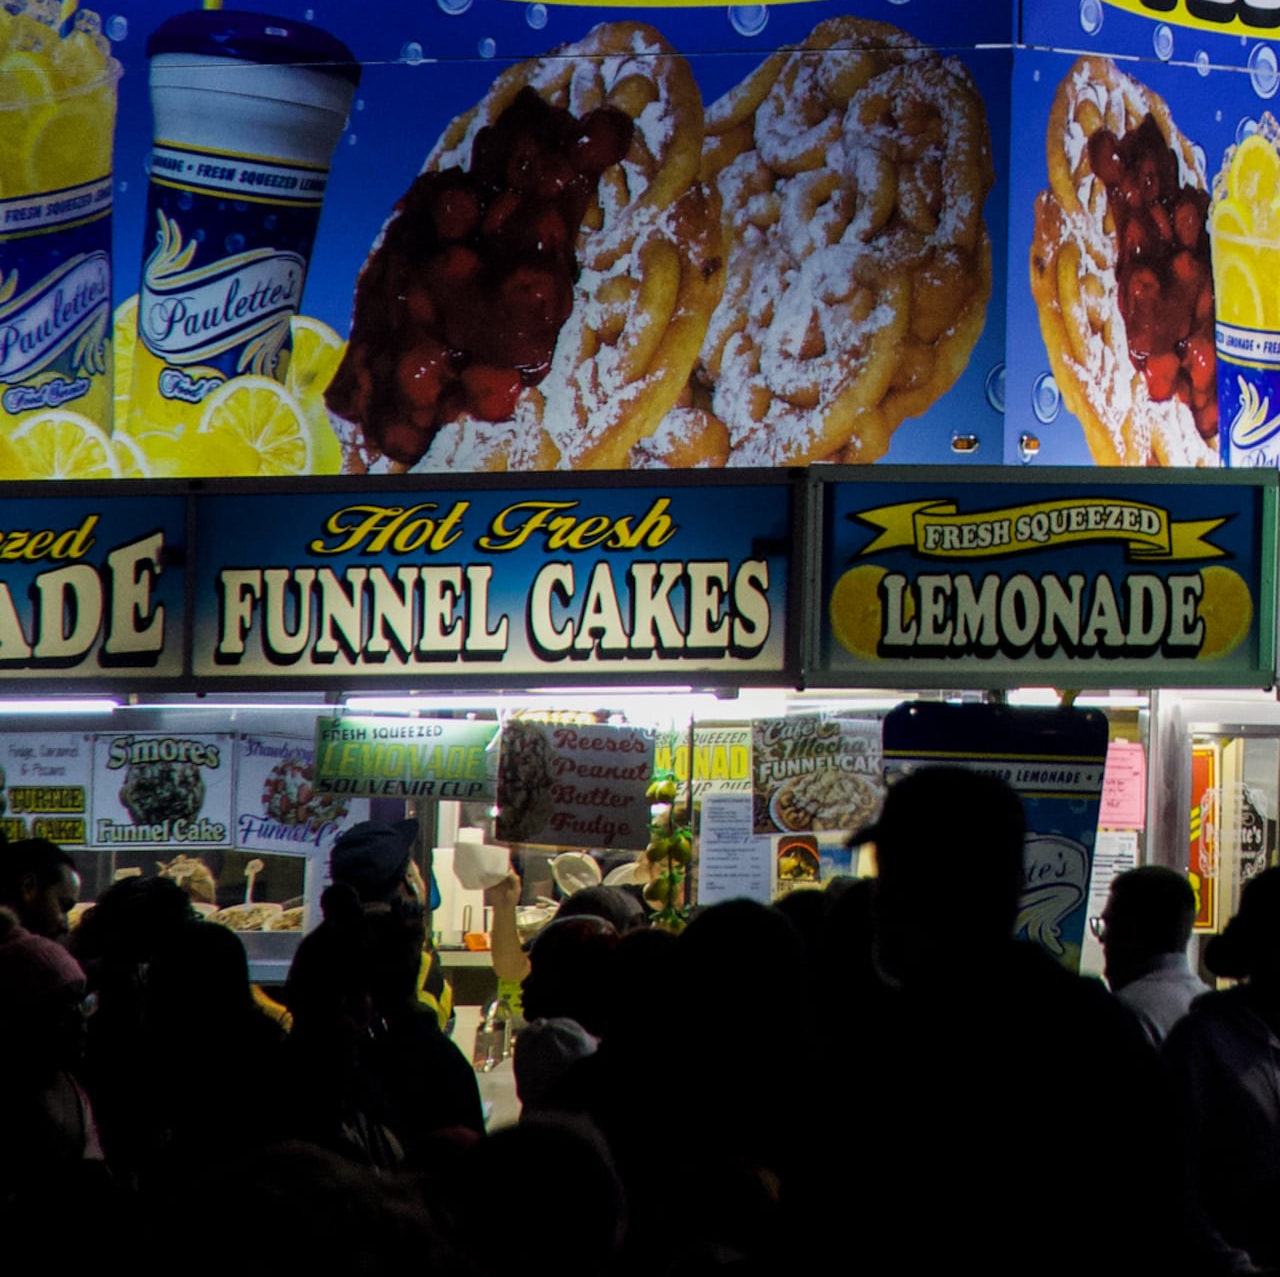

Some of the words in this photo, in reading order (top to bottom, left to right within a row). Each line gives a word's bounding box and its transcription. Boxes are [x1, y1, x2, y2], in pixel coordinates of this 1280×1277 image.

[196, 164, 236, 181] FRESH
[150, 270, 296, 342] Paulette's
[306, 501, 471, 556] Hot
[478, 498, 679, 552] Fresh
[922, 522, 1012, 551] FRESH
[1015, 505, 1162, 543] SQUEEZED
[214, 562, 509, 666] FUNNEL
[527, 560, 771, 666] CAKES
[877, 572, 1208, 660] LEMONADE
[322, 728, 366, 742] FRESH
[372, 725, 443, 739] SQUEEZED
[553, 728, 649, 754] Reese's
[784, 735, 869, 758] Mocha
[107, 736, 220, 770] S'mores
[320, 742, 482, 781] LEMONADE
[552, 756, 651, 782] Peanut
[758, 756, 840, 784] FUNNEL
[1015, 770, 1082, 784] LEMONADE
[319, 778, 434, 797] SOUVENIR
[439, 780, 483, 798] CUP
[551, 784, 636, 808] Butter
[97, 818, 173, 843] Funnel
[173, 820, 227, 843] Cake
[239, 813, 311, 844] Funnel
[551, 811, 632, 846] Fudge
